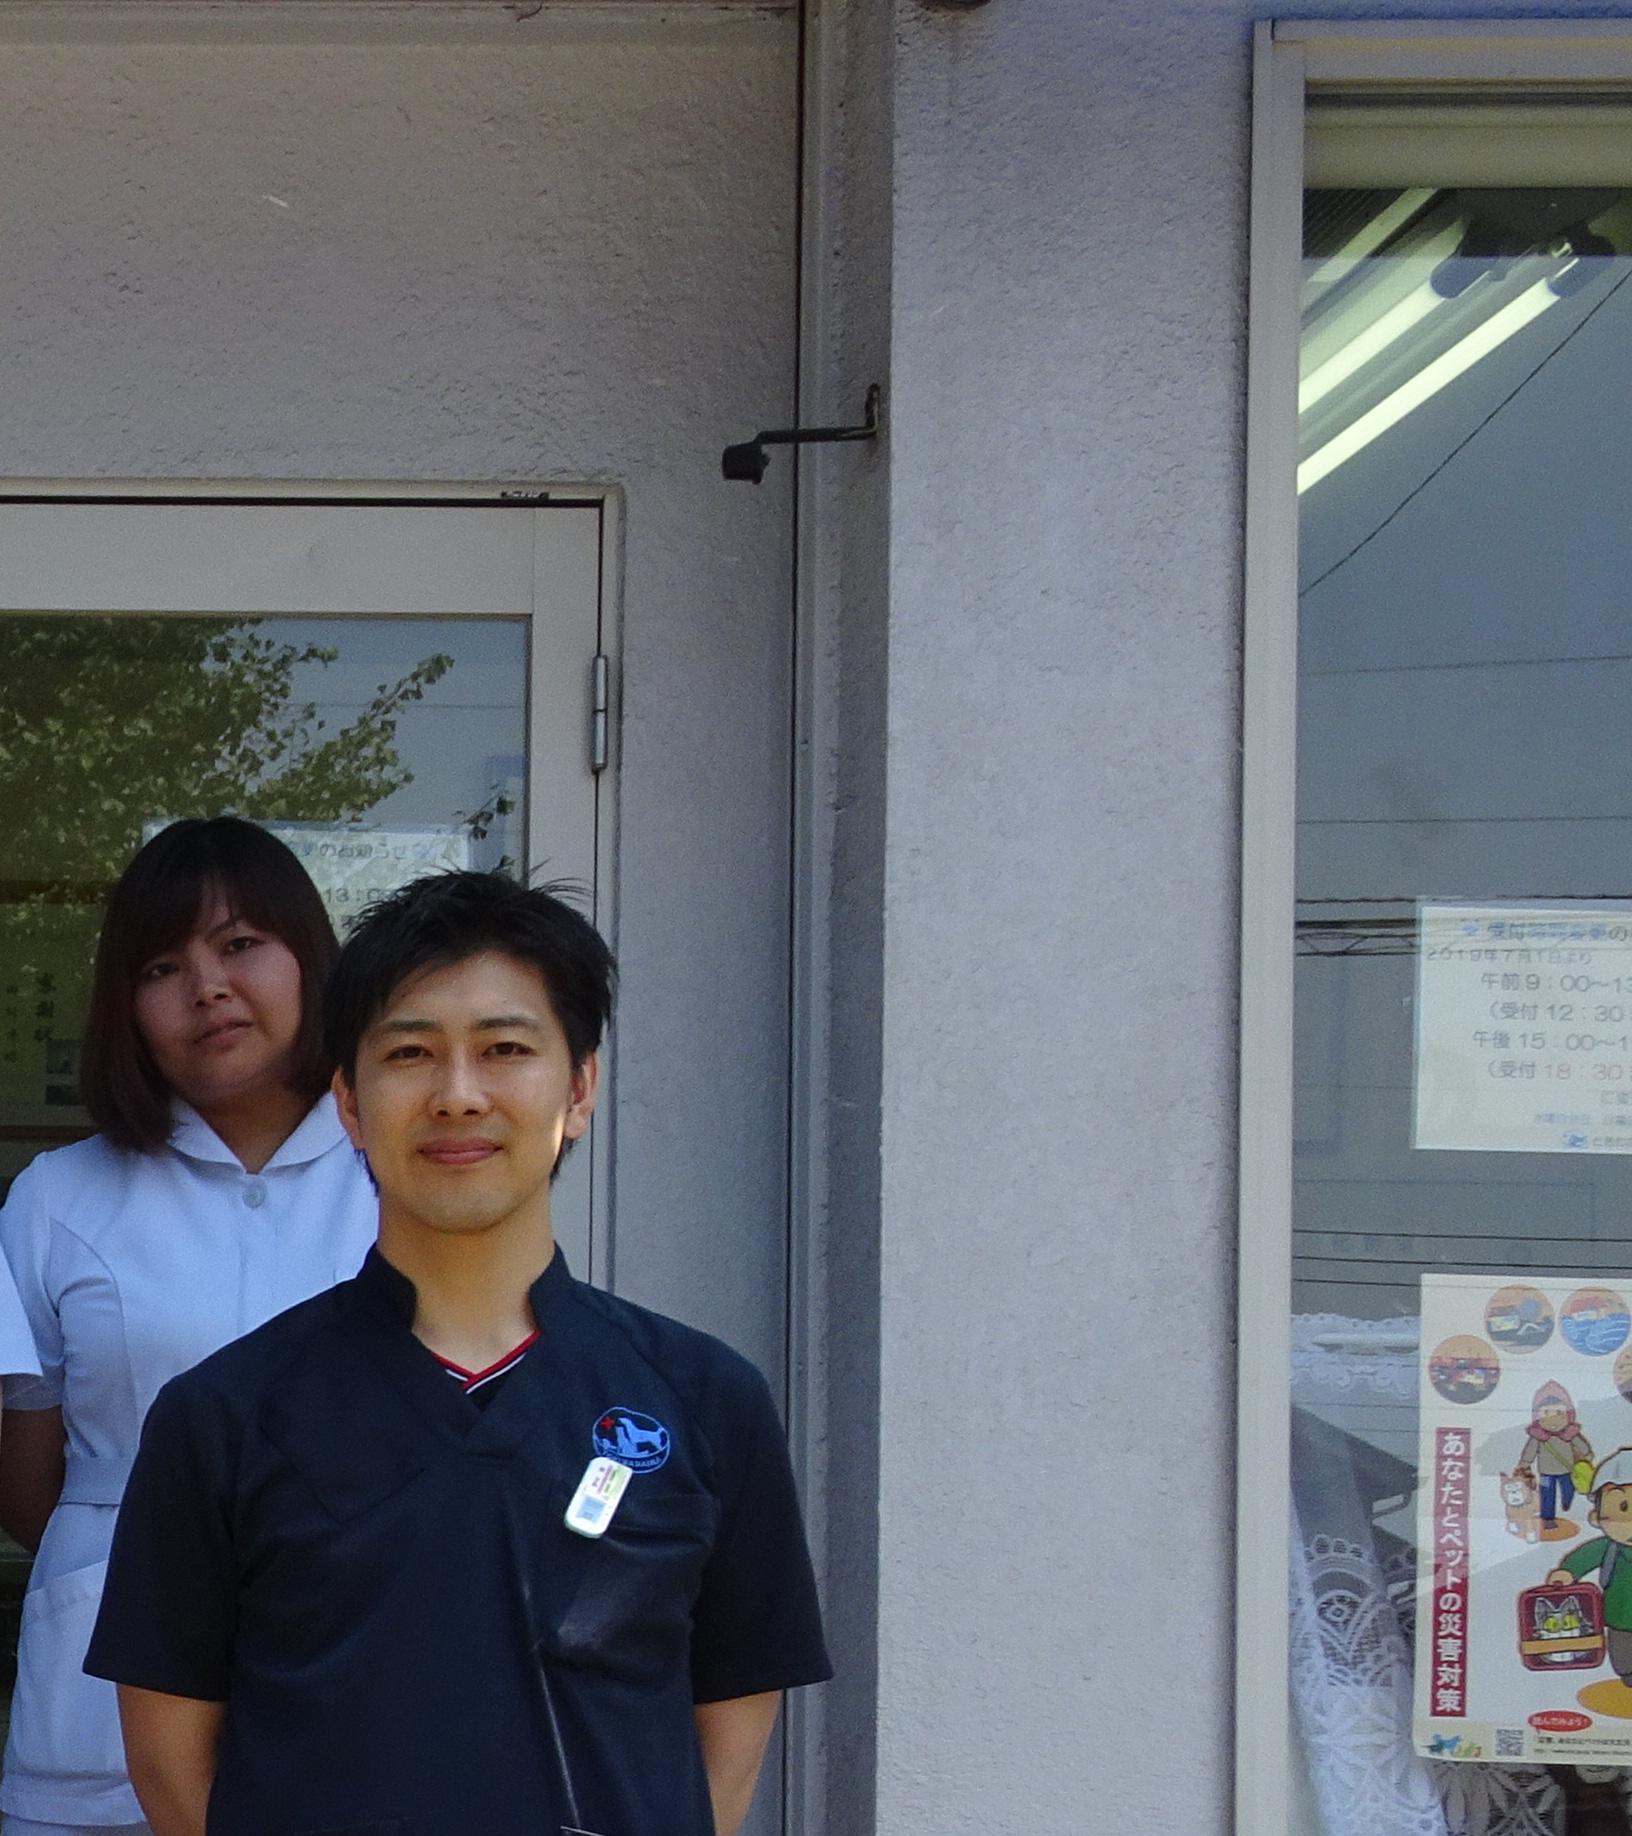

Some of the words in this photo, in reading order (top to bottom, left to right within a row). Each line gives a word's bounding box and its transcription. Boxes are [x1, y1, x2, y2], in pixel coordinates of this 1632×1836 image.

[1435, 1432, 1467, 1713] あなたとペットの災害対策
